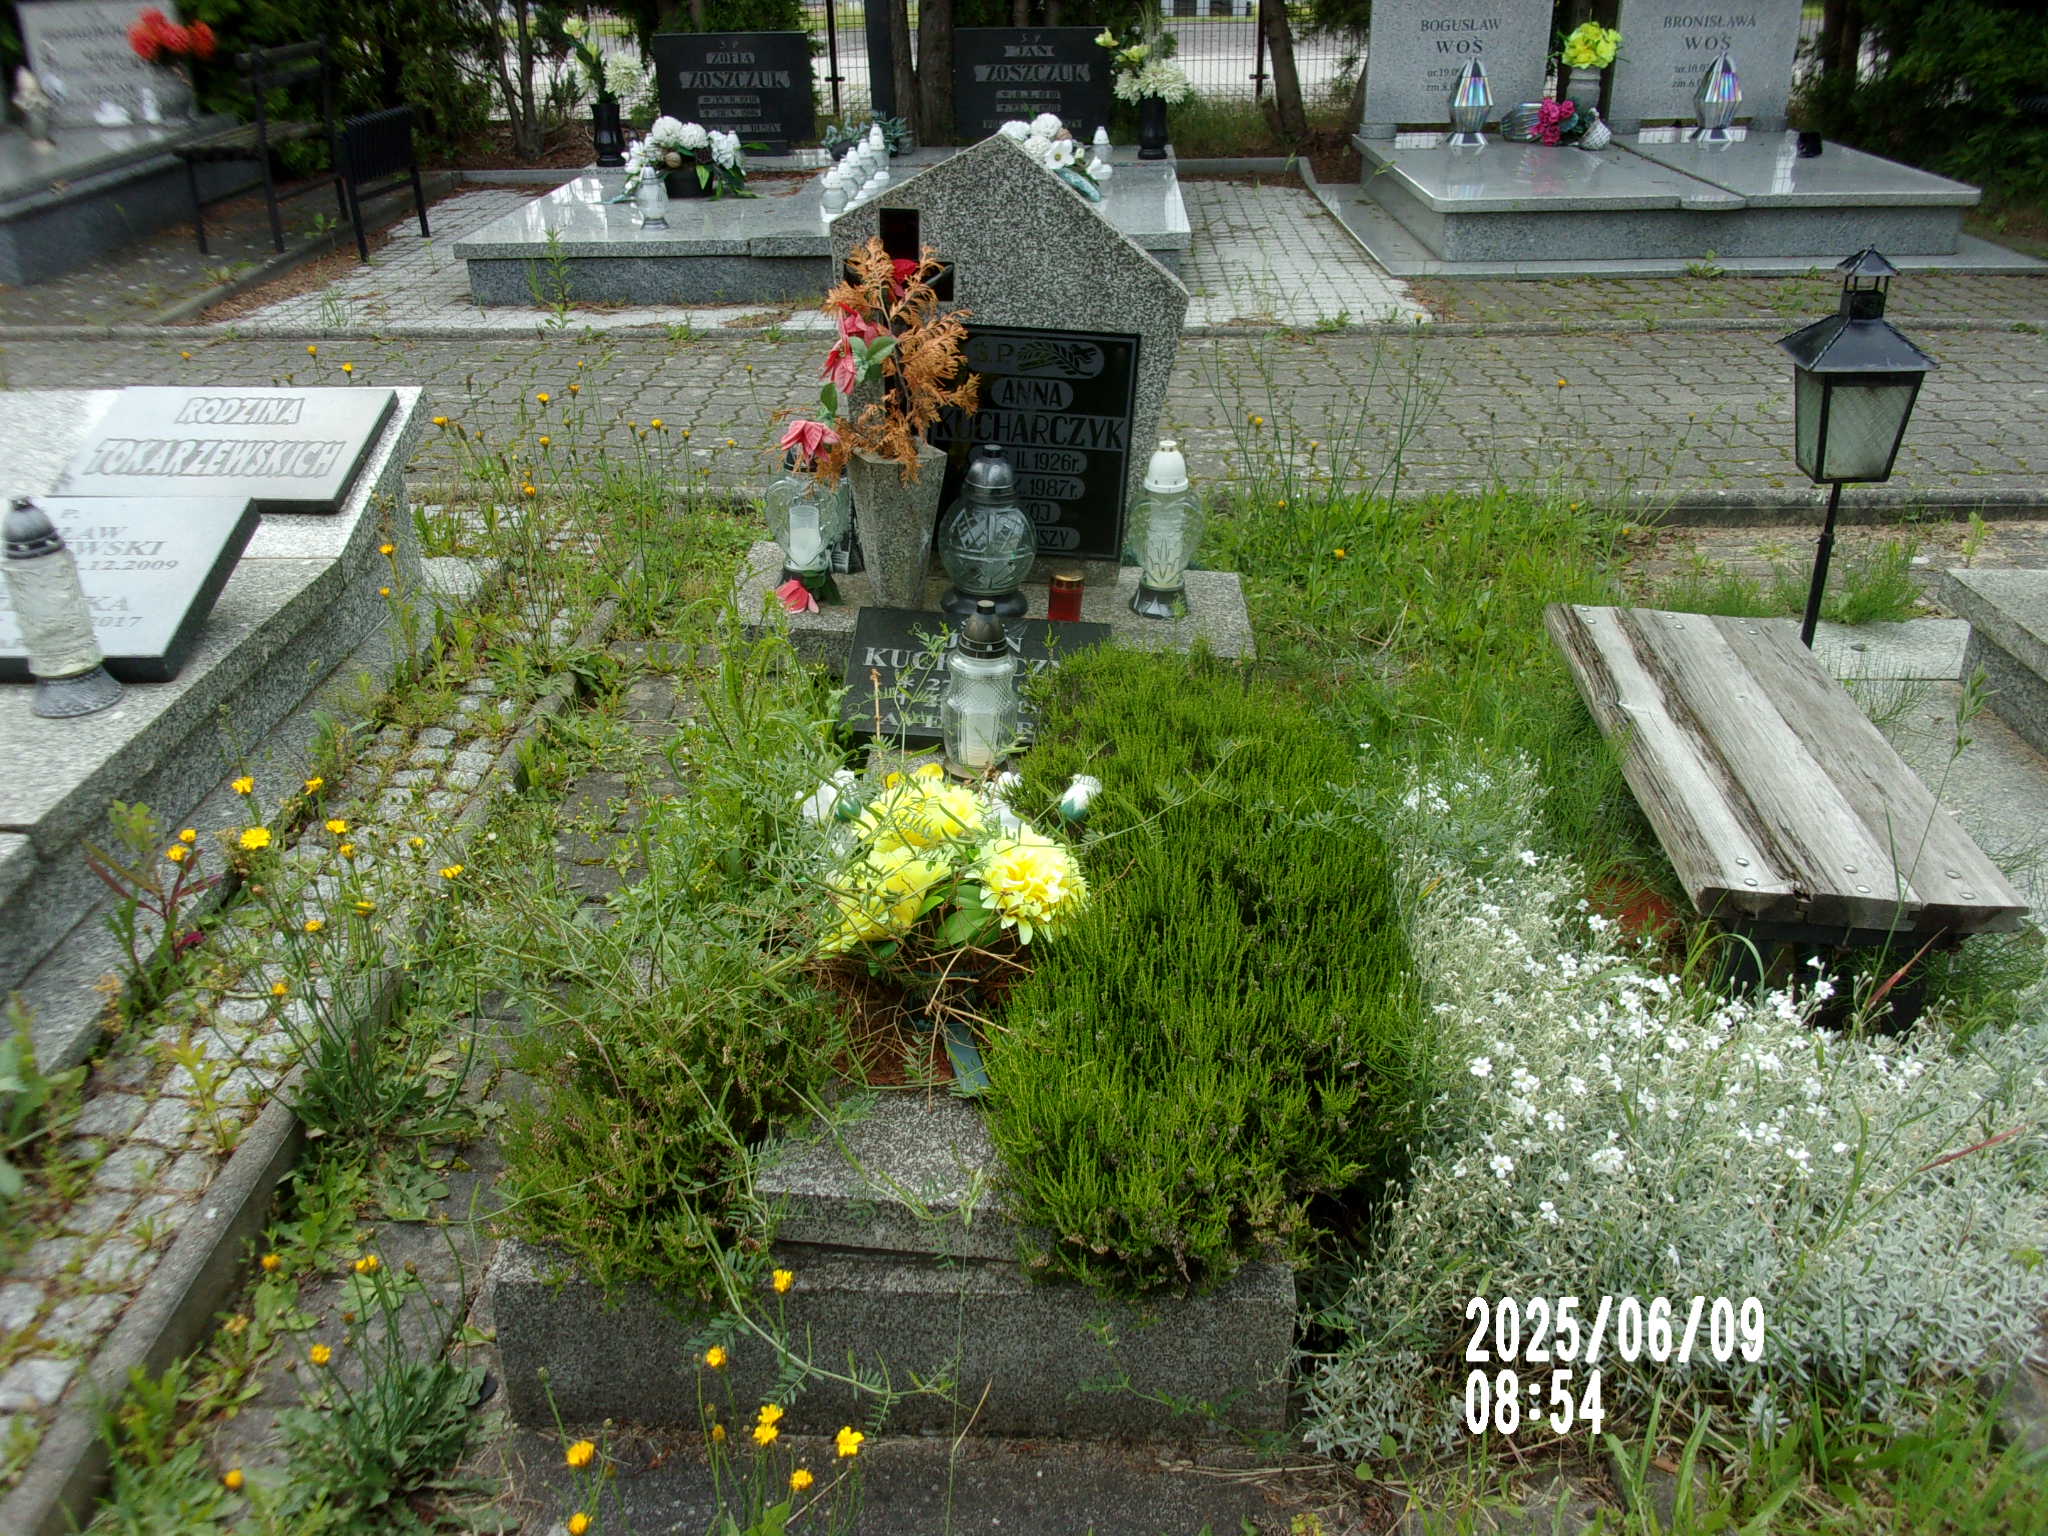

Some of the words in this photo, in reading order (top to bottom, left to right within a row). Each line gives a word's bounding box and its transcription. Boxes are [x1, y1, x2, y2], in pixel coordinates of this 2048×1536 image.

[1002, 379, 1063, 407] ANNA
[176, 397, 304, 425] RODZINA
[936, 407, 1123, 449] KUCHARCZYK
[83, 439, 346, 477] TOKARZEWSKICH
